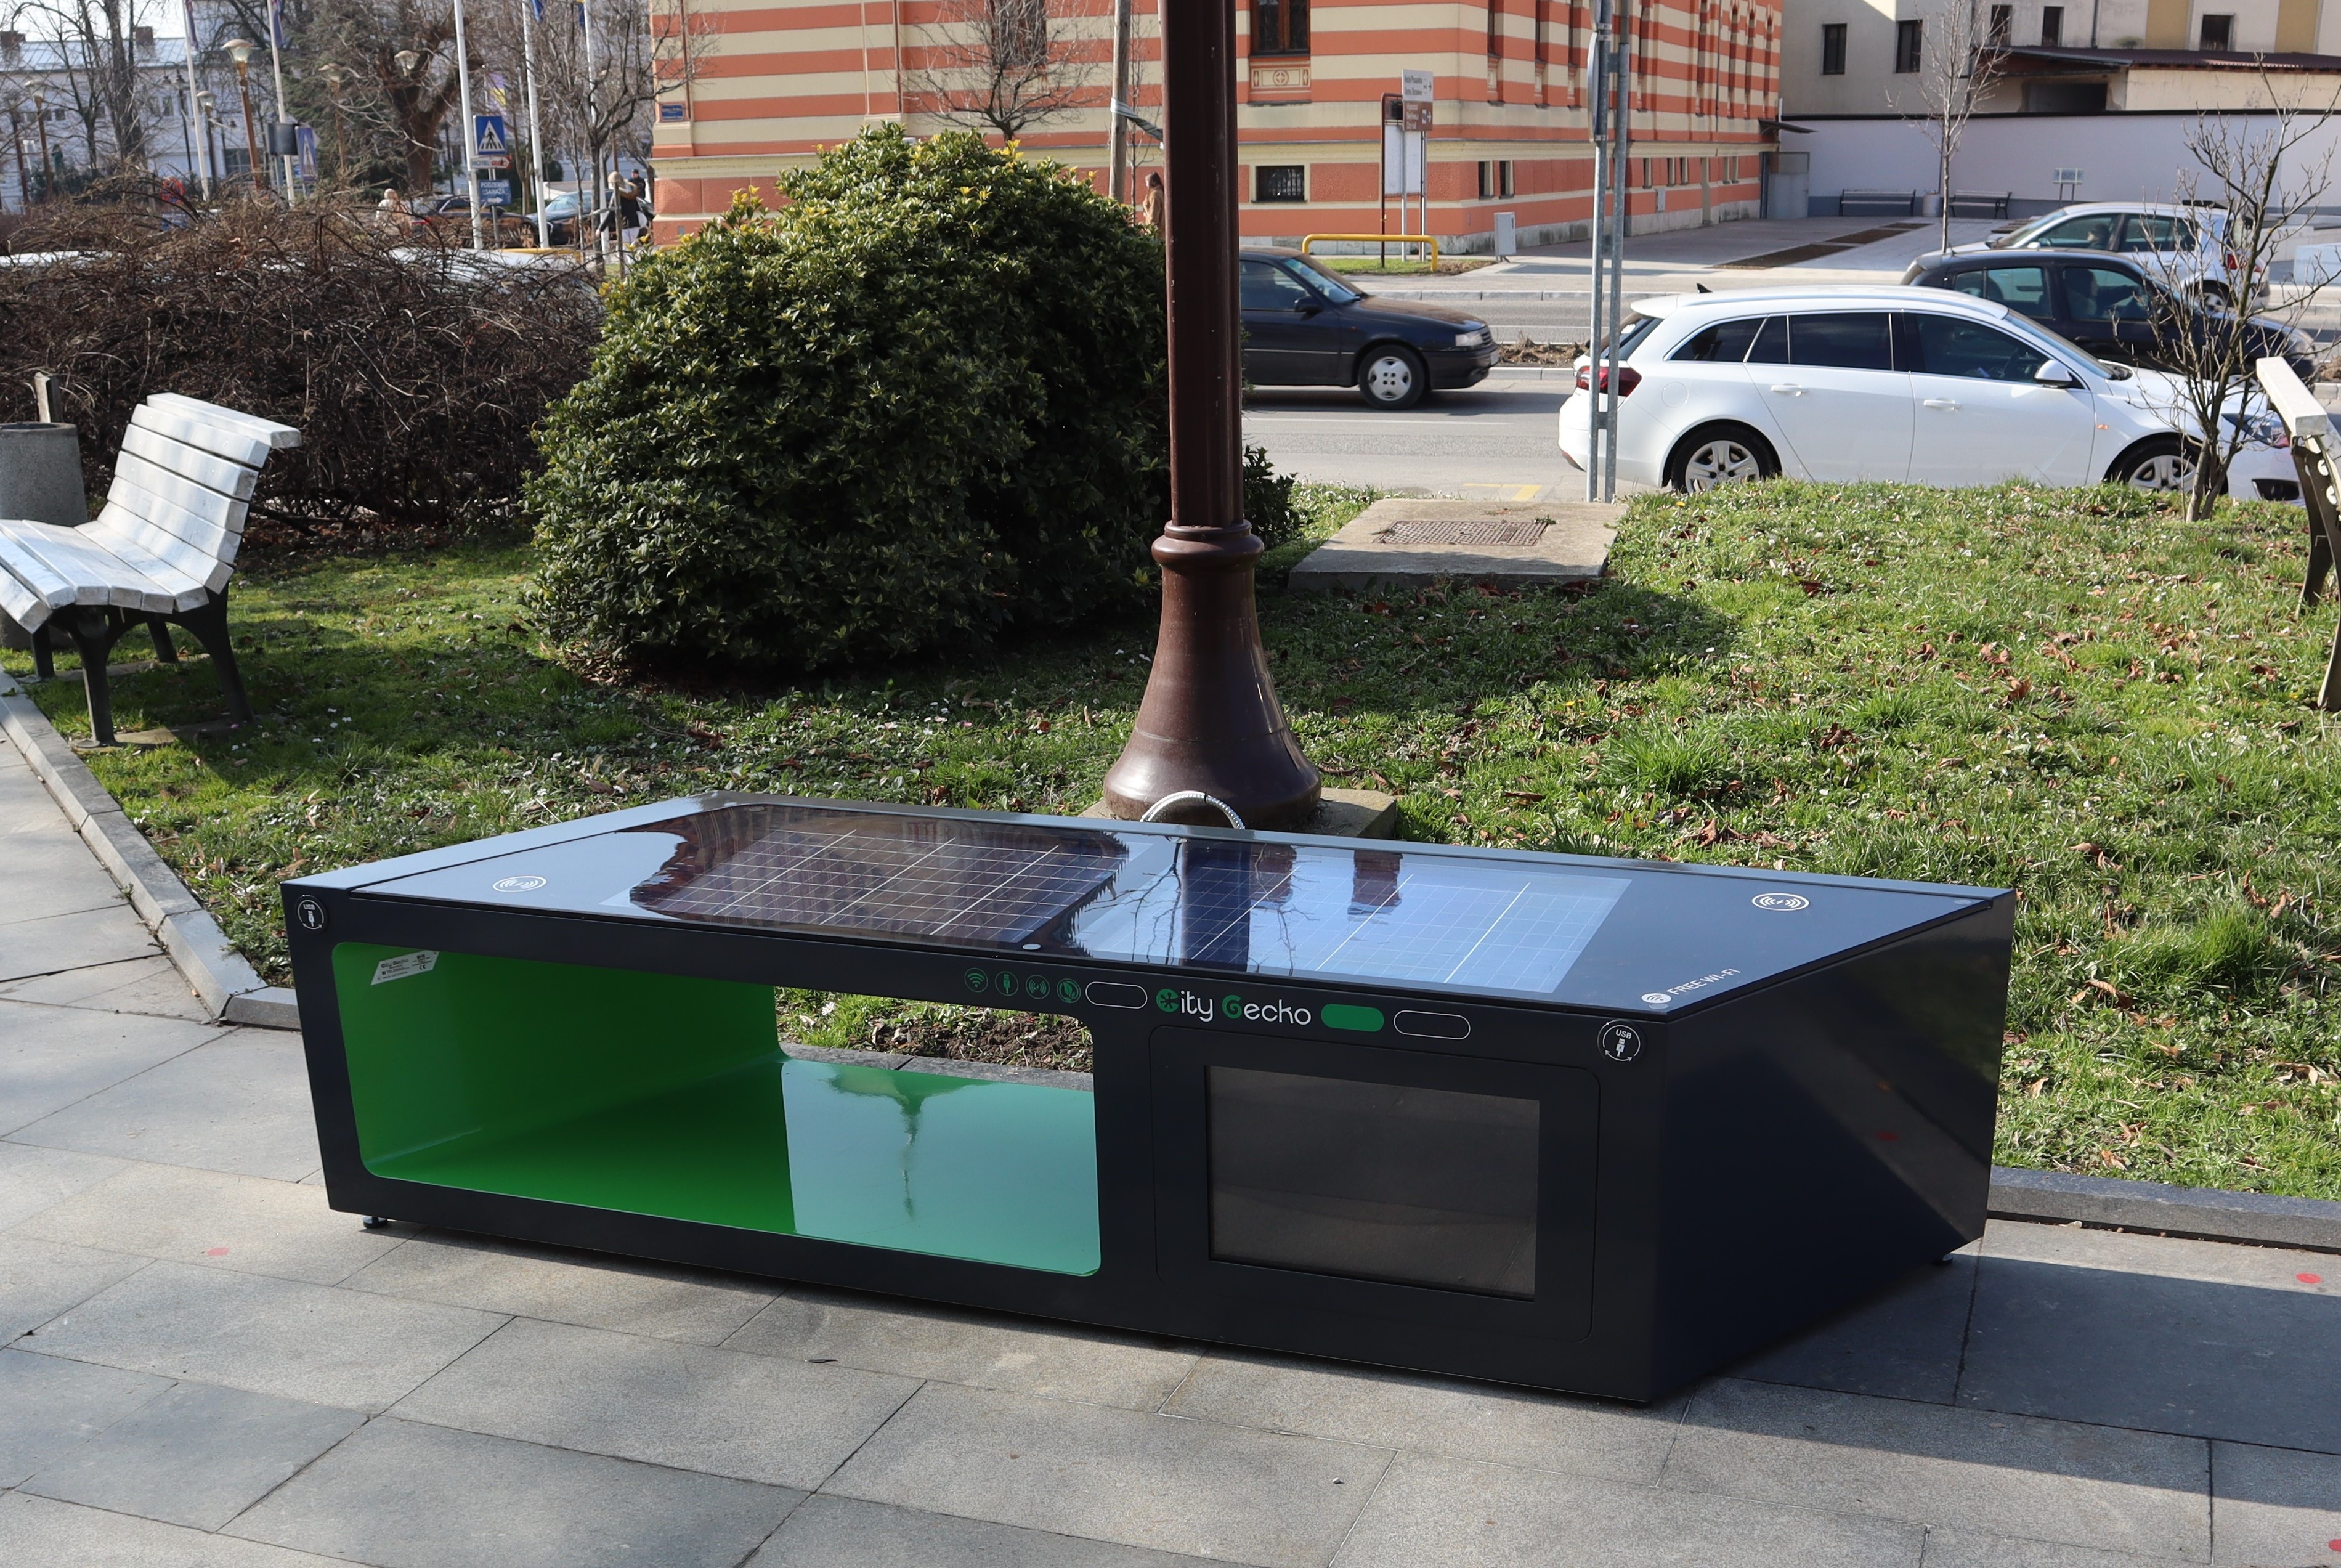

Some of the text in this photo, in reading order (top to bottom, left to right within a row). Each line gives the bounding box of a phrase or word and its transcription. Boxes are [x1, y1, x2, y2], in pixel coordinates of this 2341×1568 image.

[1666, 968, 1742, 996] FREE WI-FI
[1156, 988, 1312, 1025] City Gecko
[1615, 1028, 1632, 1039] USB
